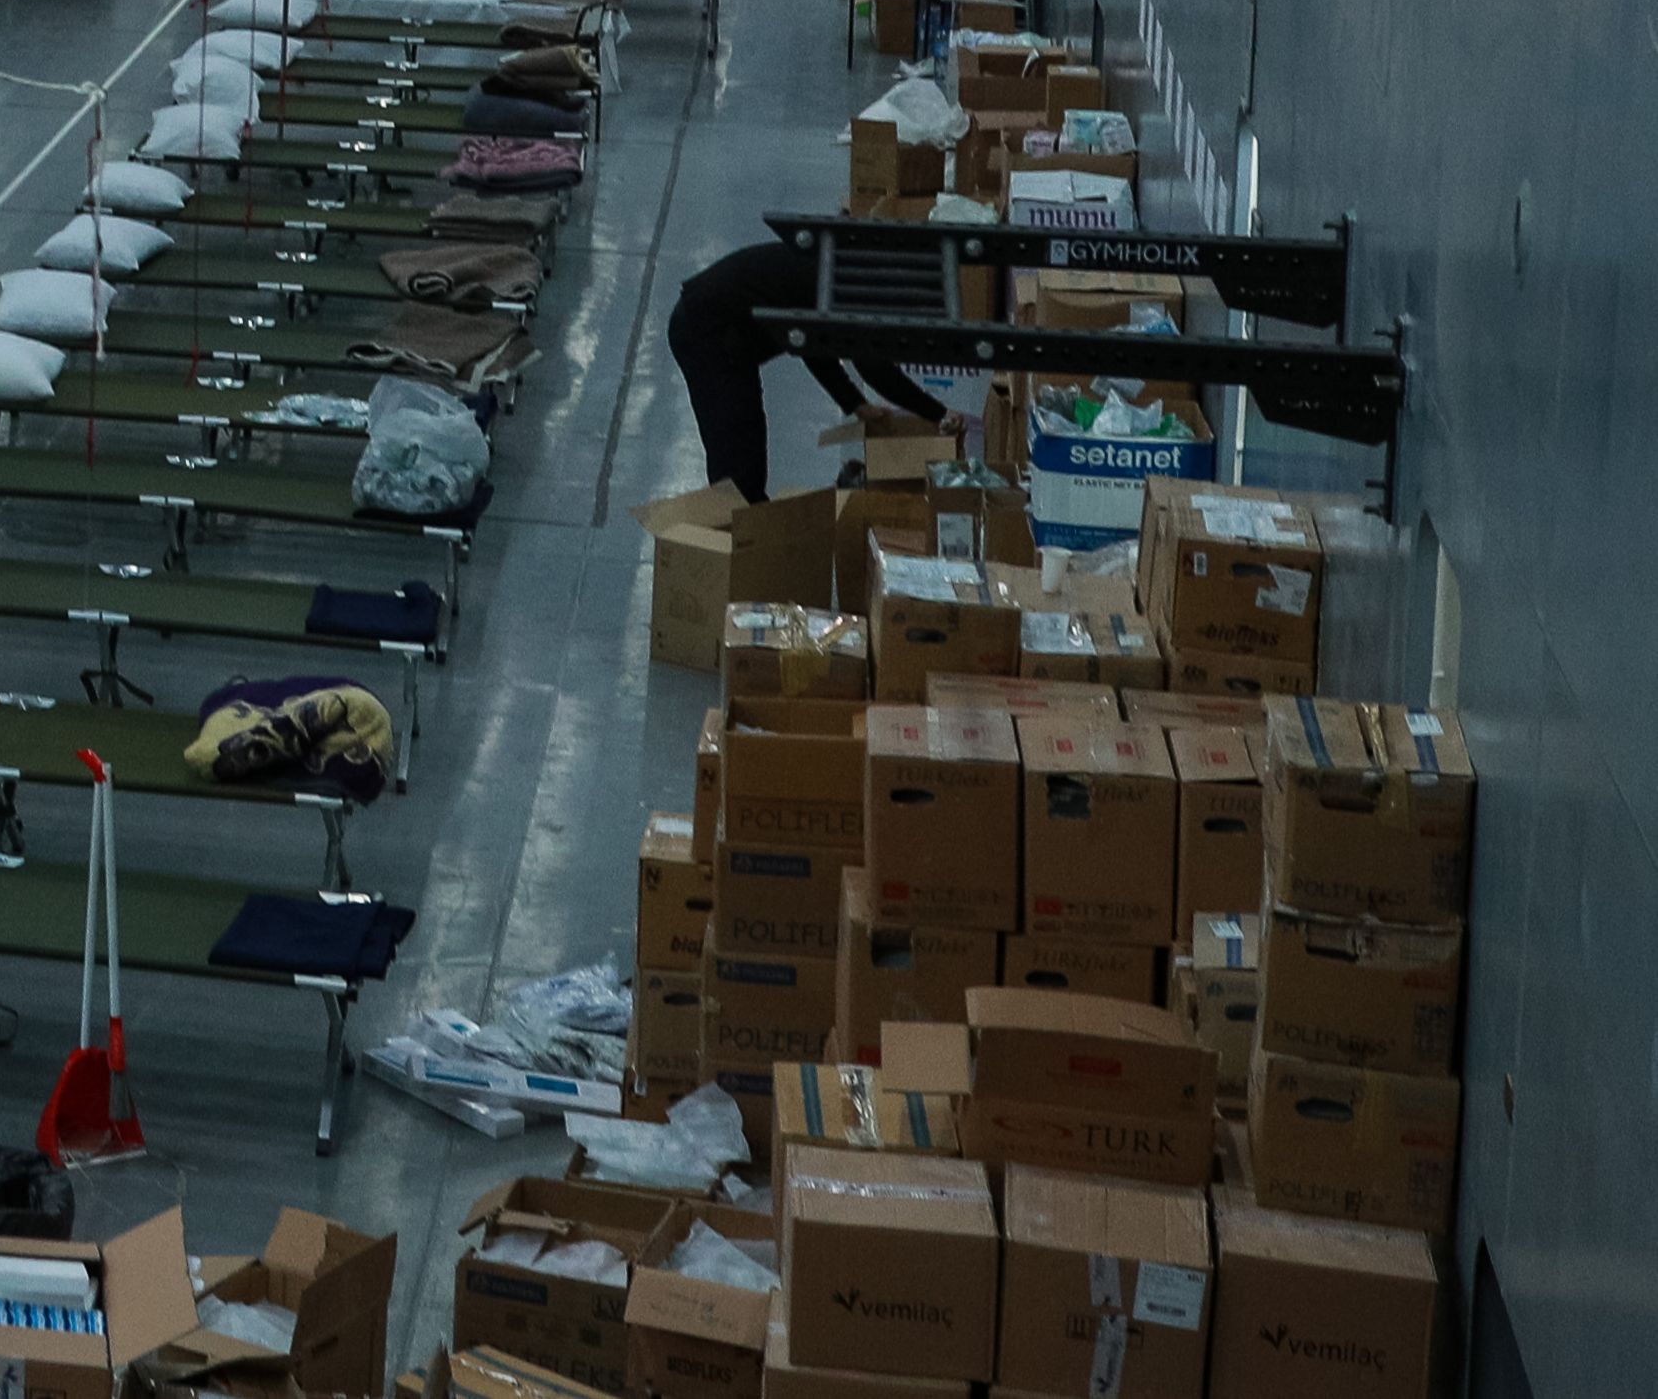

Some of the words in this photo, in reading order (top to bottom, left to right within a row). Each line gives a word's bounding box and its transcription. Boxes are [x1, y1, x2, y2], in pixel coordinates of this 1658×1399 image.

[1029, 207, 1117, 229] mumu
[1070, 239, 1200, 266] GYMHOLIX
[1069, 444, 1182, 469] setanet
[740, 807, 863, 835] POLIFLE
[733, 917, 837, 946] POLIFL
[718, 1025, 824, 1055] POLIFL
[859, 1300, 954, 1329] vemilaç
[1288, 1337, 1388, 1374] vemilaç
